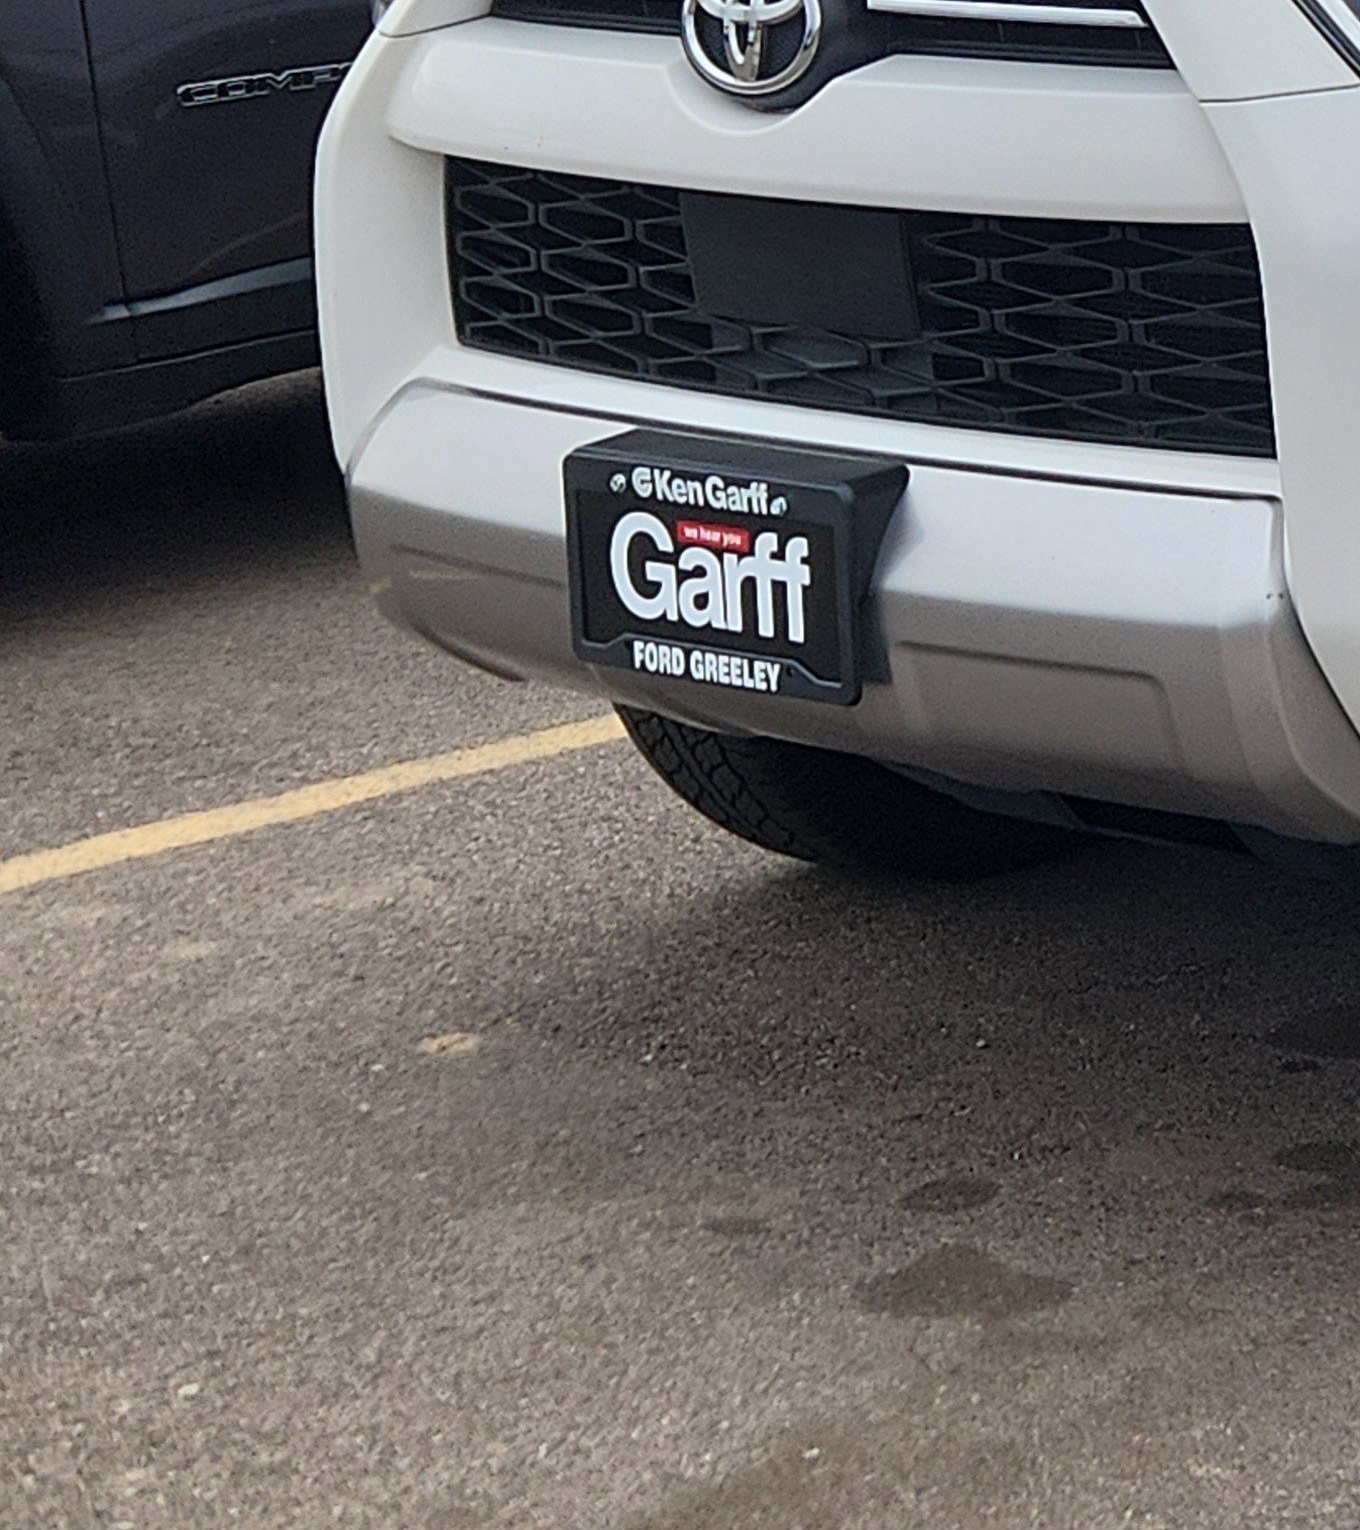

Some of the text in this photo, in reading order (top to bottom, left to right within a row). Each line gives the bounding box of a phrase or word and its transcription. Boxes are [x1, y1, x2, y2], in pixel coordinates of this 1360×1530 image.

[176, 62, 354, 107] COMP
[653, 468, 769, 516] Ken Garff
[610, 511, 811, 644] Garff
[632, 640, 780, 693] FORD GREELEY
